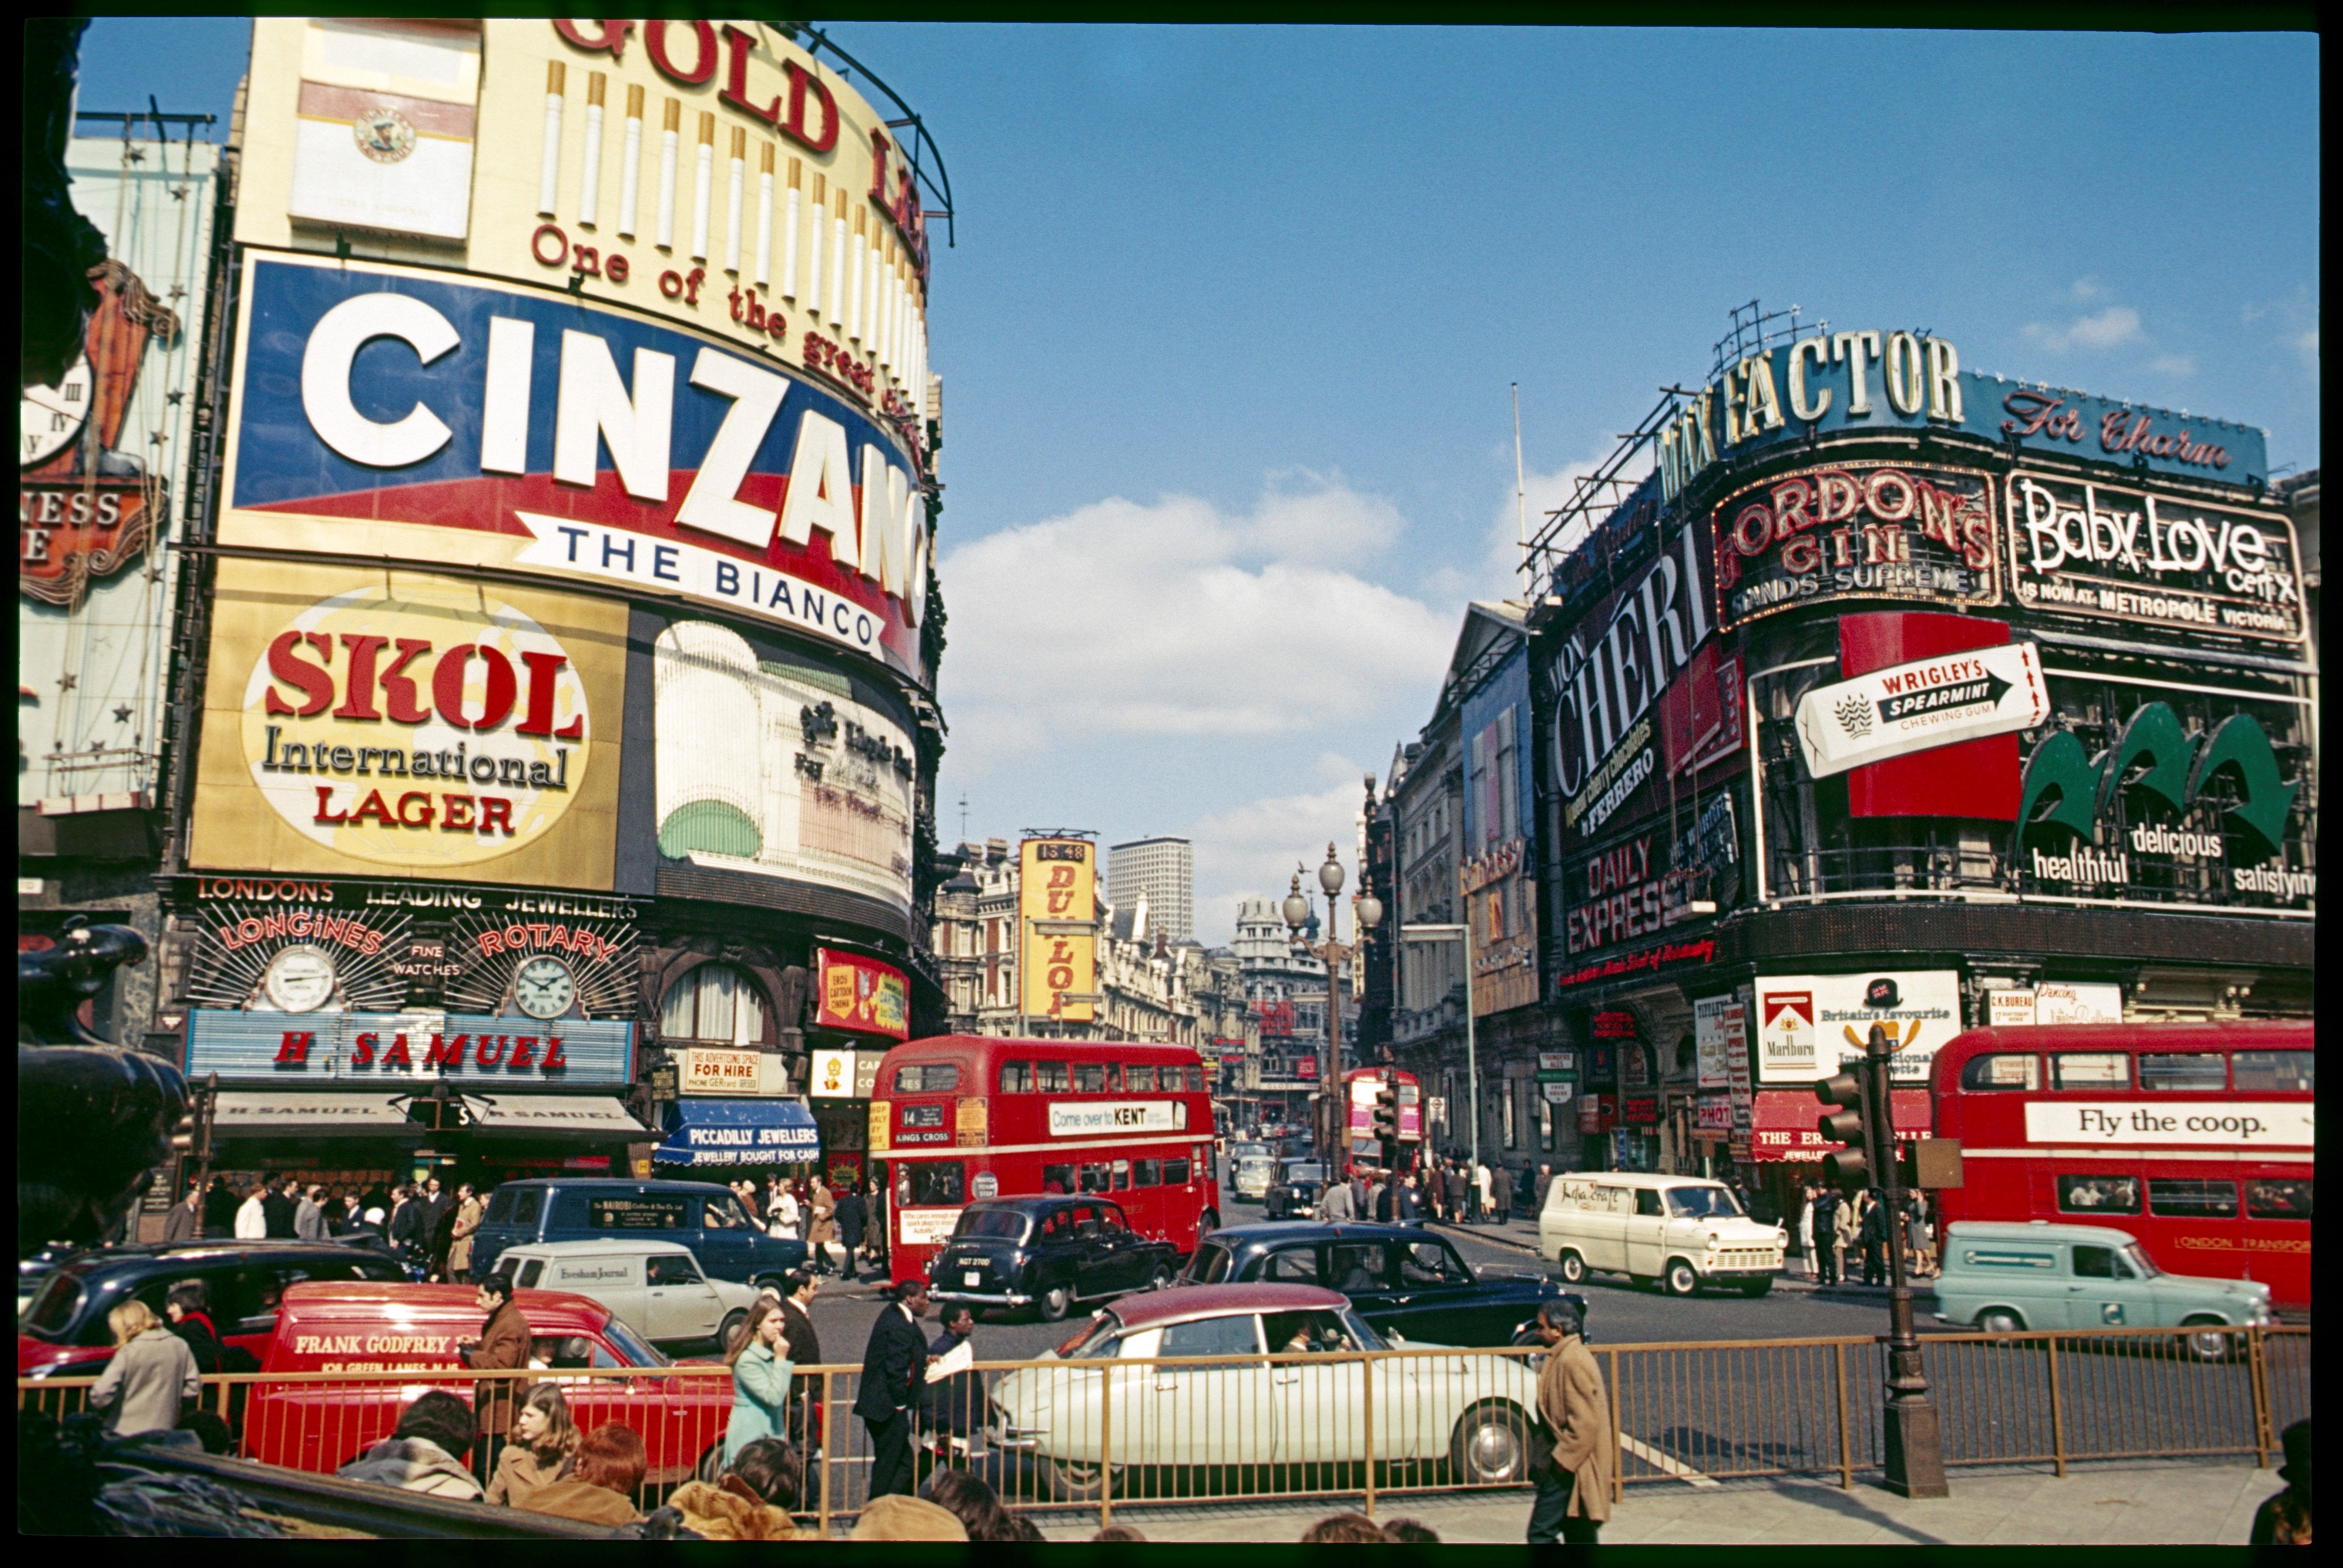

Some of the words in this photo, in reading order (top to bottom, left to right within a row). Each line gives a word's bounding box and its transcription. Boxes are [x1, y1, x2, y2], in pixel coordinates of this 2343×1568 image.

[532, 224, 629, 281] One
[659, 268, 706, 304] of
[729, 286, 786, 338] the
[804, 331, 875, 394] great
[1723, 330, 1965, 449] FACTOR
[2001, 391, 2088, 441] For
[2100, 410, 2232, 468] Charm
[302, 292, 926, 628] CINZANO
[2020, 478, 2141, 574] Baby
[2146, 495, 2267, 574] Love
[1782, 523, 1902, 573] GIN
[557, 525, 681, 582] THE
[717, 559, 872, 645] BIANCO
[1835, 567, 1969, 592] SUPREME
[2022, 581, 2038, 598] IS
[2040, 584, 2074, 603] NOW
[2099, 590, 2218, 623] METROPOLE
[2222, 609, 2286, 630] VICTORIA
[265, 631, 583, 738] SKOL
[1882, 658, 1984, 695] WRIGLEY'S
[1890, 683, 1989, 715] SPEARMINT
[1901, 709, 1962, 730] CHEWING
[1966, 704, 1991, 717] GUM
[262, 725, 567, 786] International
[1588, 748, 1653, 834] FERRERO
[313, 787, 516, 833] LAGER
[2133, 822, 2222, 857] delicious
[1588, 835, 1652, 898] DAILY
[2033, 848, 2128, 883] healthful
[366, 885, 481, 909] LEADING
[505, 896, 637, 919] JEWELLERS
[411, 946, 443, 959] FINE
[478, 925, 617, 962] ROTARY
[1046, 866, 1076, 1014] DULOP
[394, 964, 460, 976] WATCHES
[2038, 981, 2077, 1004] Dancing
[1821, 1009, 1880, 1021] Britain's
[1883, 1007, 1950, 1019] favourite
[351, 1032, 566, 1067] SAMUEL
[692, 1052, 704, 1063] THIS
[706, 1053, 741, 1064] ADVERTISING
[742, 1054, 759, 1065] SPACE
[1768, 1035, 1814, 1056] Marlboro
[695, 1064, 719, 1076] FOR
[725, 1066, 752, 1077] HIRE
[515, 1111, 622, 1119] SAMUEL
[904, 1111, 915, 1125] 14
[1053, 1111, 1081, 1127] Come
[1083, 1115, 1102, 1126] over
[1104, 1112, 1113, 1126] to
[1114, 1108, 1146, 1125] KENT
[2079, 1110, 2120, 1137] Fly
[2132, 1110, 2176, 1132] the
[2187, 1114, 2267, 1138] coop.
[690, 1129, 753, 1145] PICCADILLY
[758, 1129, 817, 1145] JEWELLERS
[924, 1133, 948, 1141] CROSS
[1760, 1132, 1791, 1145] THE
[693, 1151, 738, 1163] JEWELLERY
[741, 1151, 776, 1162] BOUGHT
[779, 1151, 796, 1161] FOR
[798, 1150, 819, 1159] CASH
[2174, 1236, 2233, 1250] LONDON
[561, 1268, 596, 1279] Evesham
[596, 1266, 628, 1279] Journal
[294, 1336, 362, 1354] FRANK
[366, 1336, 451, 1354] GODFREY
[346, 1363, 383, 1372] GREEN
[389, 1363, 427, 1371] LANES
